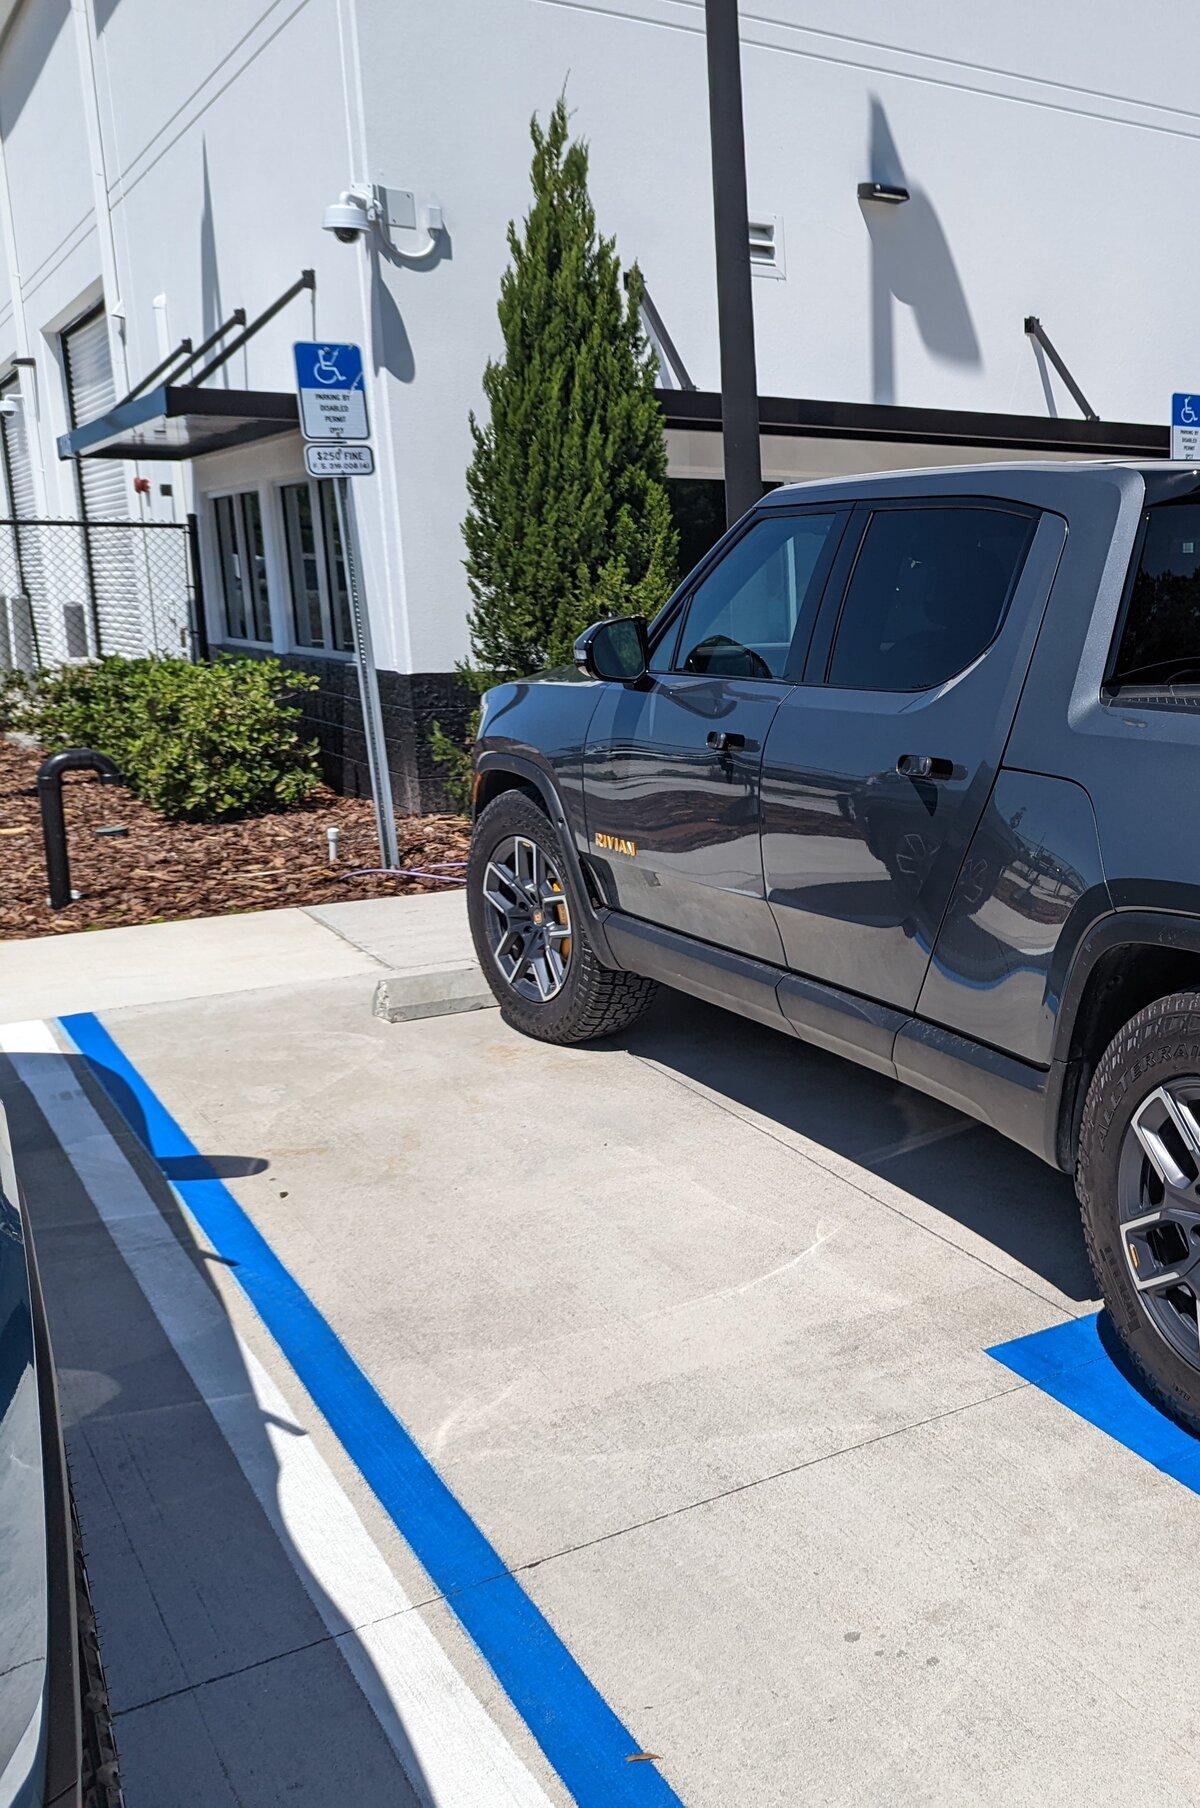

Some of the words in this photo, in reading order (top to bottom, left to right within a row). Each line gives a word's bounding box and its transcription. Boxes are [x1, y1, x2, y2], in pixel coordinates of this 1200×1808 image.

[315, 393, 341, 402] PARKING
[320, 404, 350, 413] DISABLED
[324, 415, 347, 423] PERMIT
[316, 451, 341, 461] $250
[343, 452, 364, 461] FINE
[594, 832, 637, 857] RIVIAN
